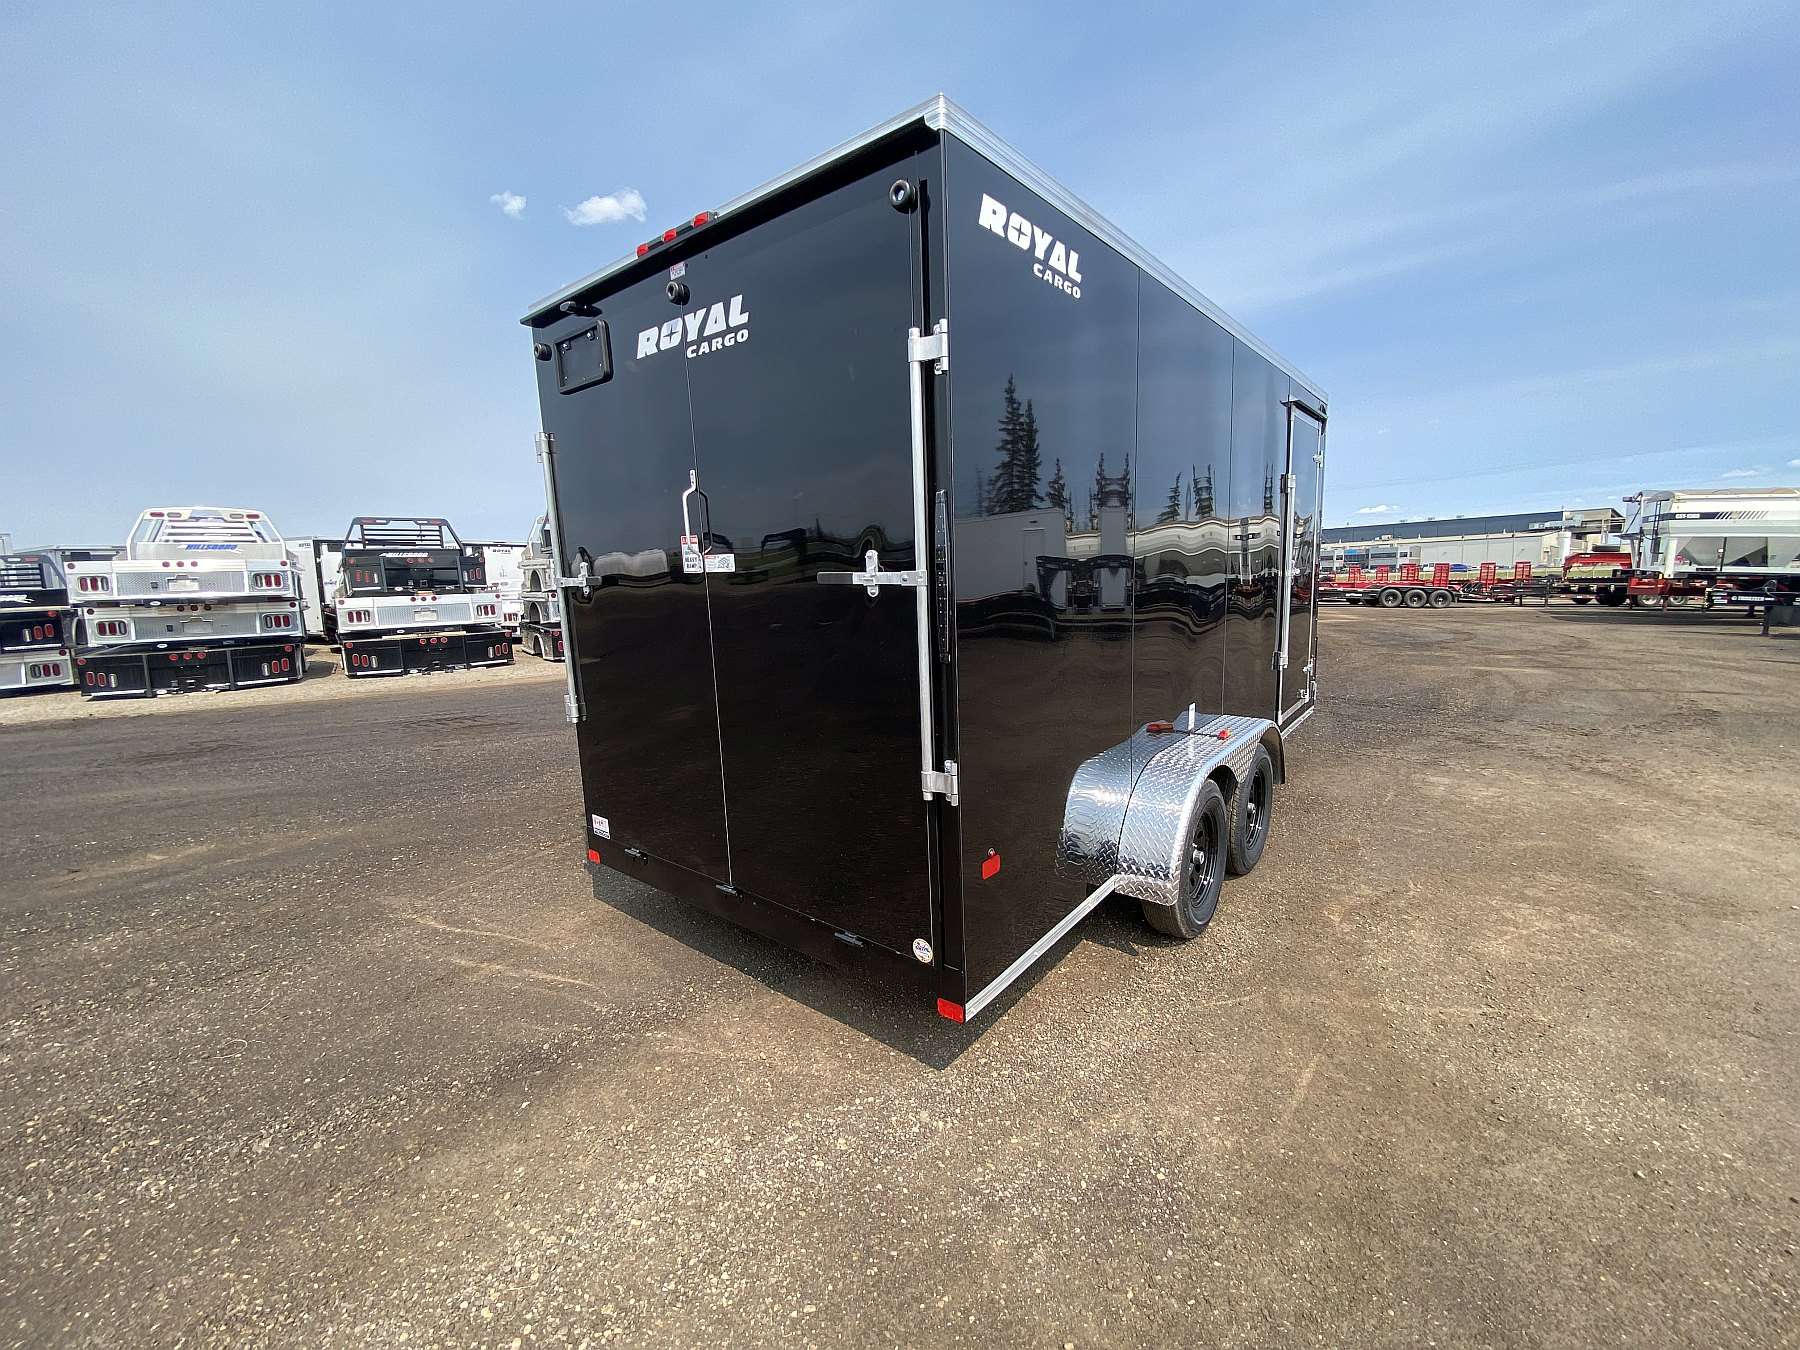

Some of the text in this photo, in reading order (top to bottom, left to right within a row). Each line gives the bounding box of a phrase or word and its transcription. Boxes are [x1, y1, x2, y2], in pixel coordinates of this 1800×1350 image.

[978, 192, 1082, 284] ROYAL
[1033, 262, 1081, 300] CARGO
[636, 294, 749, 360] ROYAL
[686, 328, 749, 359] CARGO
